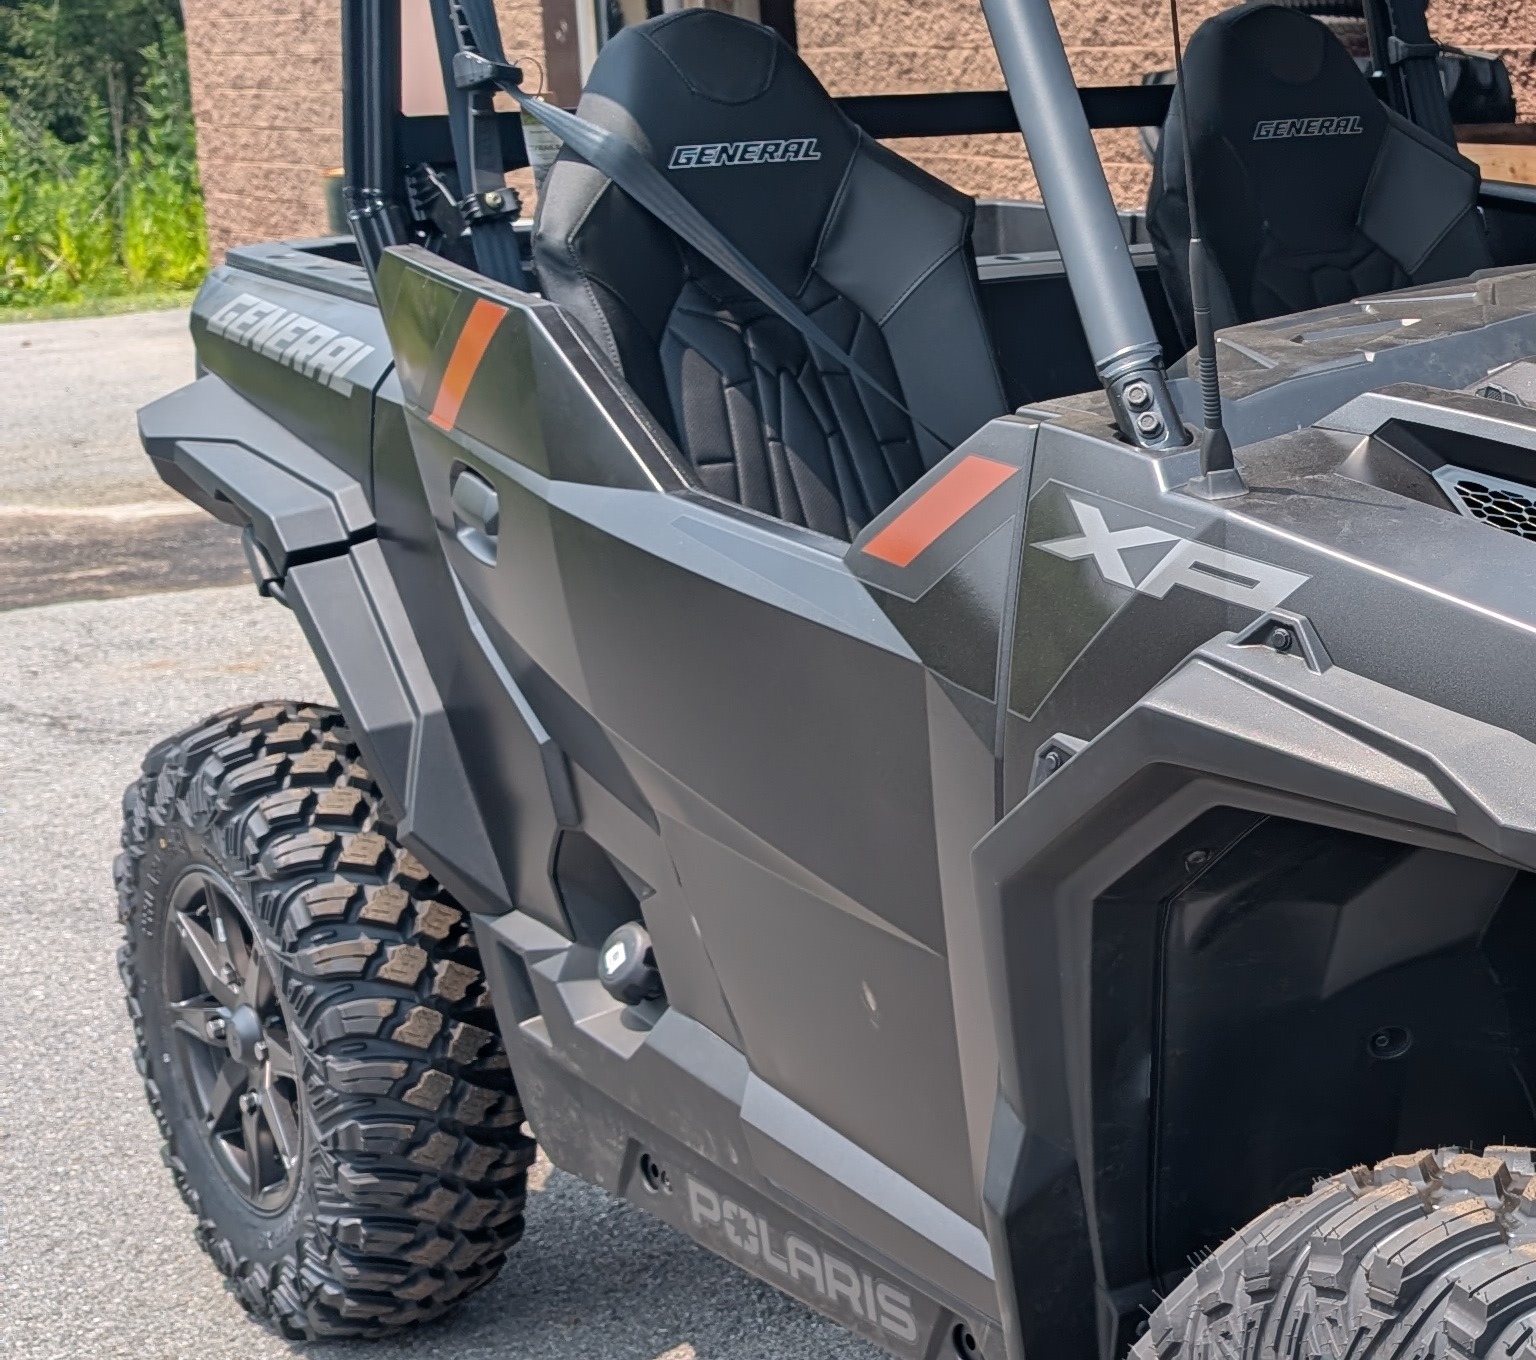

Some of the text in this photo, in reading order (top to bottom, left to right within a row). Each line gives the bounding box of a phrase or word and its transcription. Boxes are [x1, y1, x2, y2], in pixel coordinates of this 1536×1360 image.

[668, 137, 822, 170] GENERAL
[1253, 116, 1363, 141] GENERAL
[206, 293, 374, 398] GENERAL
[1033, 498, 1312, 611] XP
[687, 1176, 917, 1342] POLARIS
